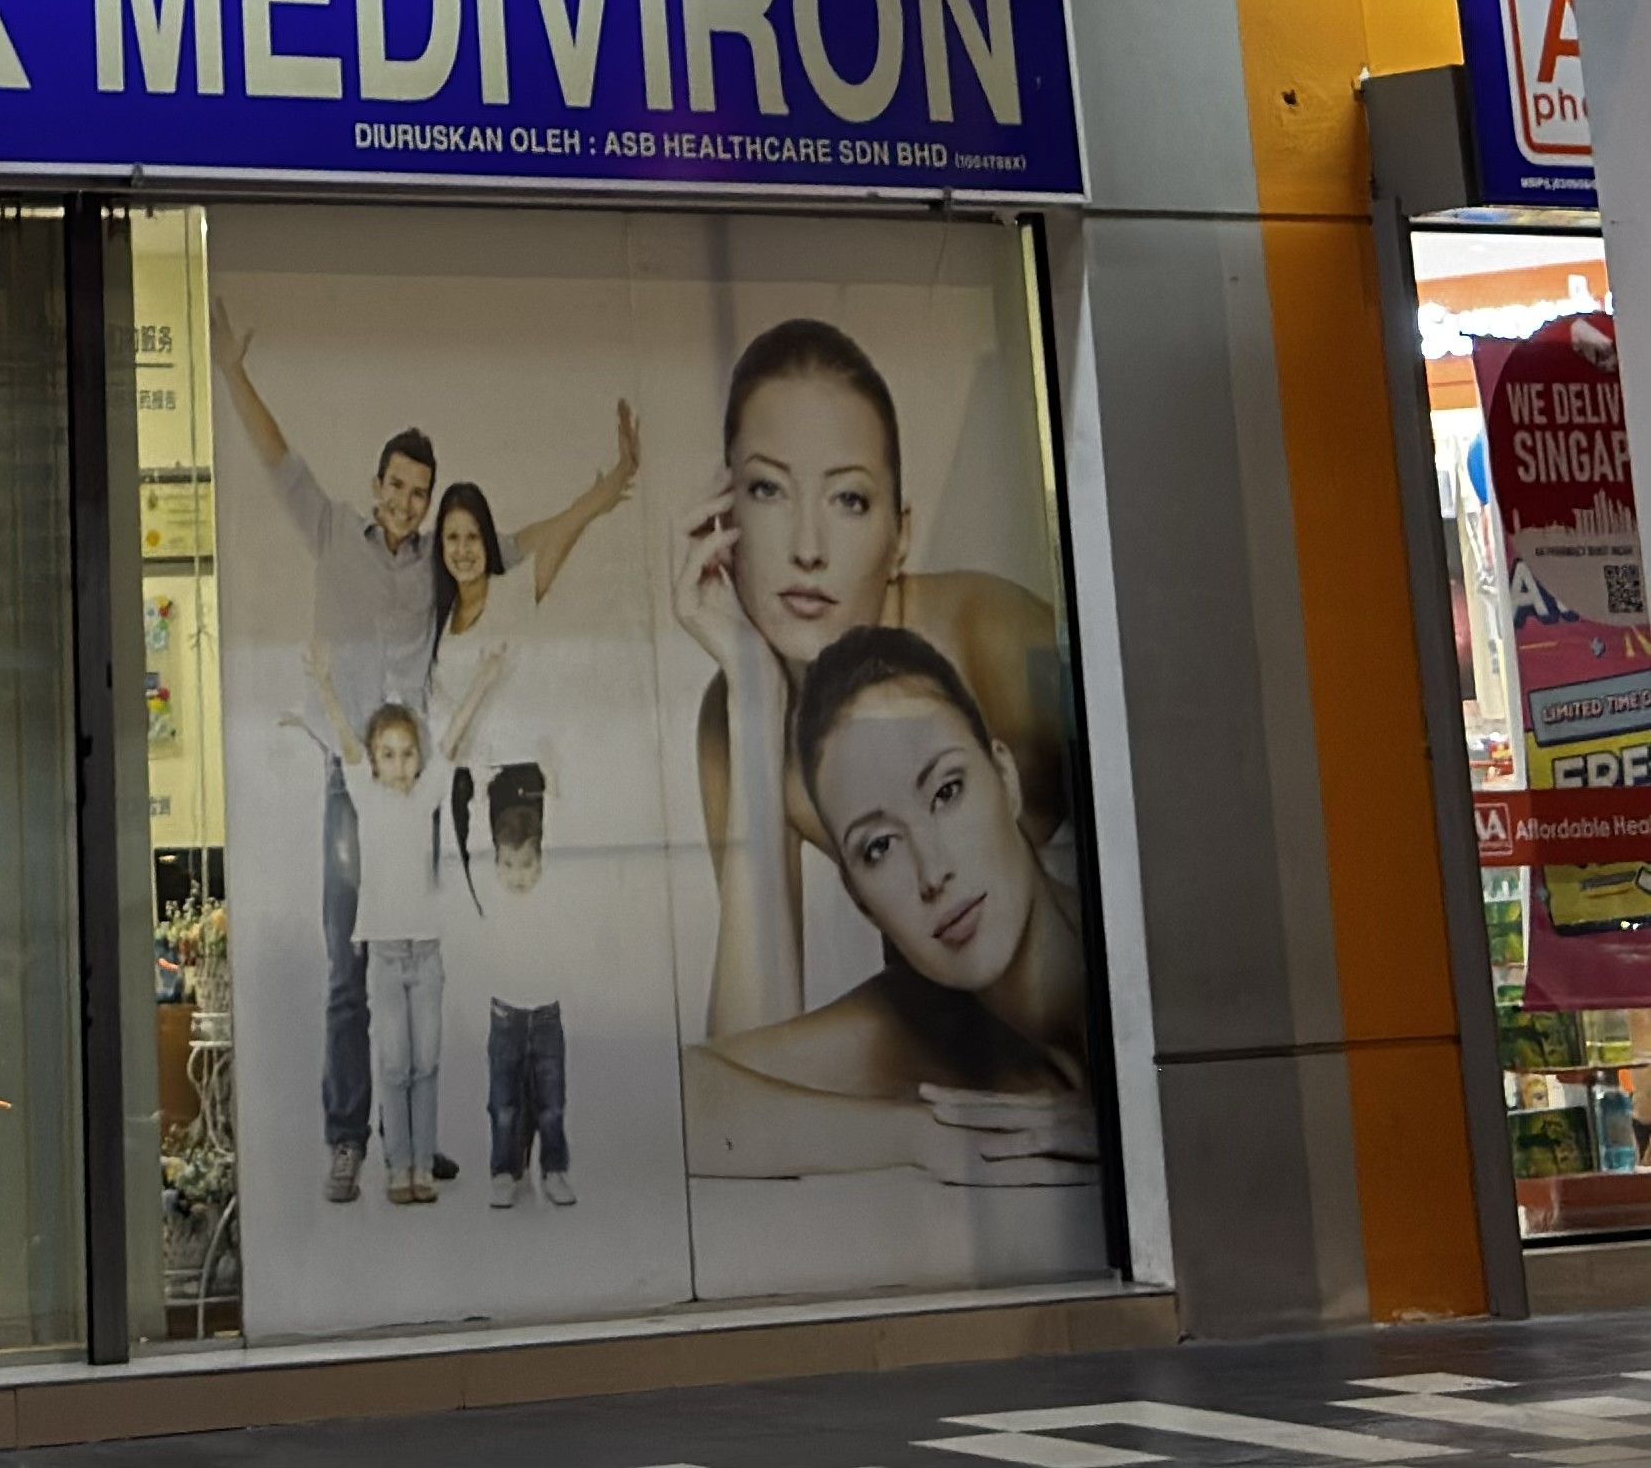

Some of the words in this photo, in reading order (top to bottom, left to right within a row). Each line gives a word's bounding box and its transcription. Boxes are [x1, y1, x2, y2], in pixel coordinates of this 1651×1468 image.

[1533, 86, 1589, 128] ph
[354, 121, 504, 154] DIURUSKAN
[509, 127, 582, 156] OLEH
[603, 129, 656, 159] ASB
[663, 133, 833, 165] HEALTHCARE
[838, 138, 890, 167] SDN
[897, 142, 948, 169] BHD
[1505, 382, 1548, 426] WE
[1543, 699, 1603, 724] LIMITED
